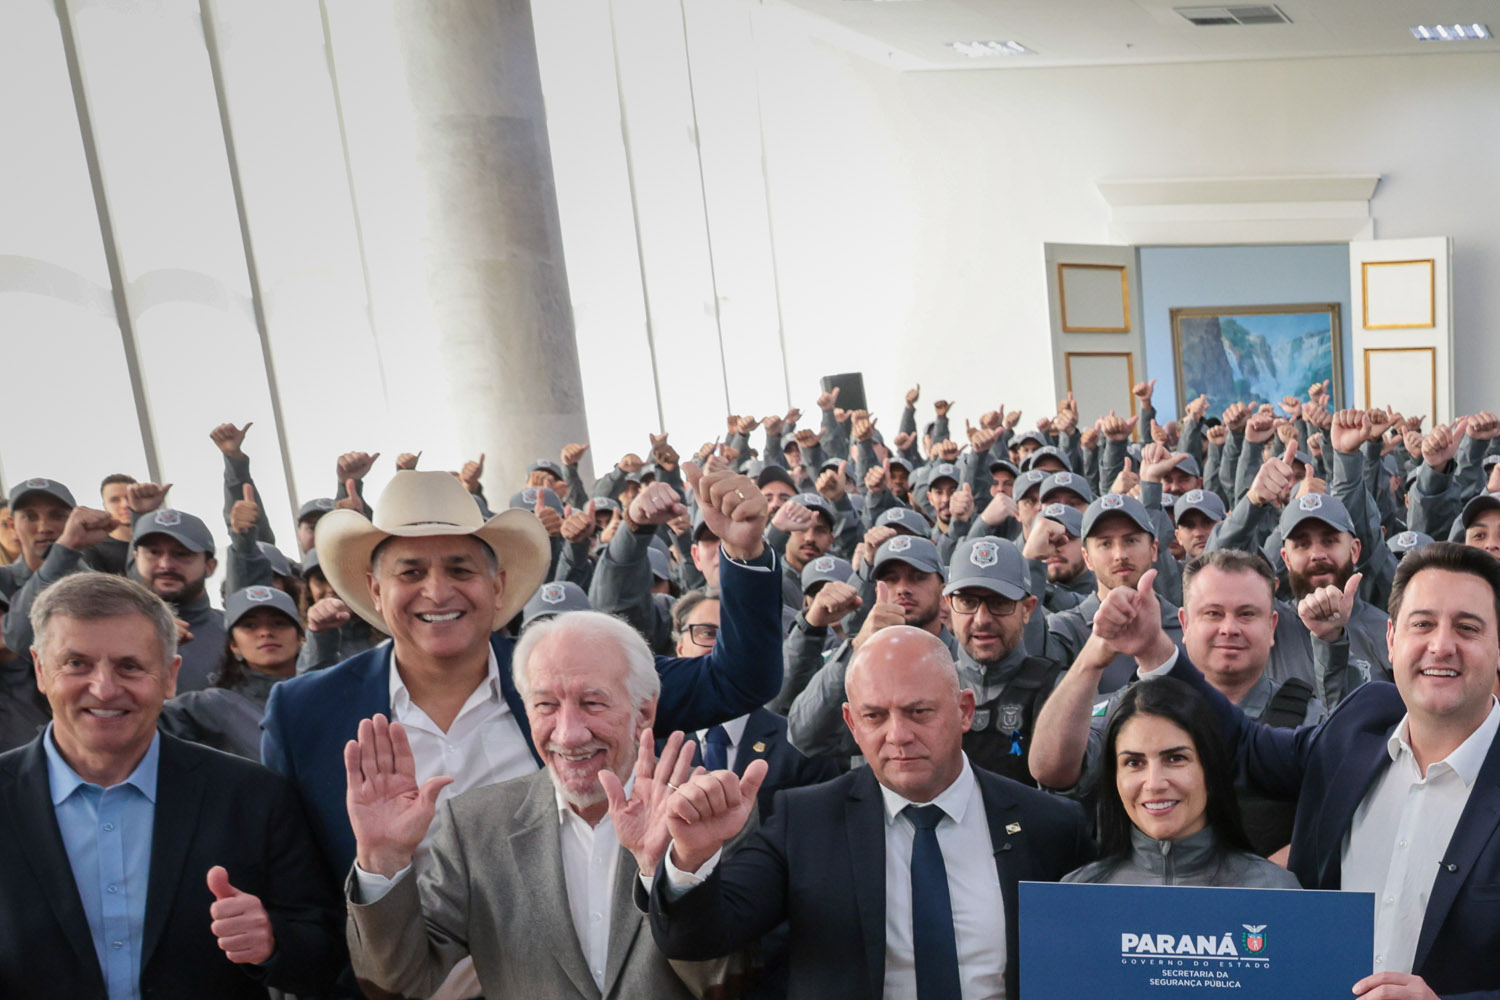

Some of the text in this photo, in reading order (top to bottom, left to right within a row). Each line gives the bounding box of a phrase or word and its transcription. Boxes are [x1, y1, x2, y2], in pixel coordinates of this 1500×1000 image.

[1121, 932, 1238, 956] PARANÁ
[1121, 959, 1184, 967] GOVERNO
[1219, 961, 1270, 969] ESTADO
[1162, 969, 1229, 979] SECRETARIA DA
[1149, 978, 1241, 988] SEGURANÇA PÚBLICA
